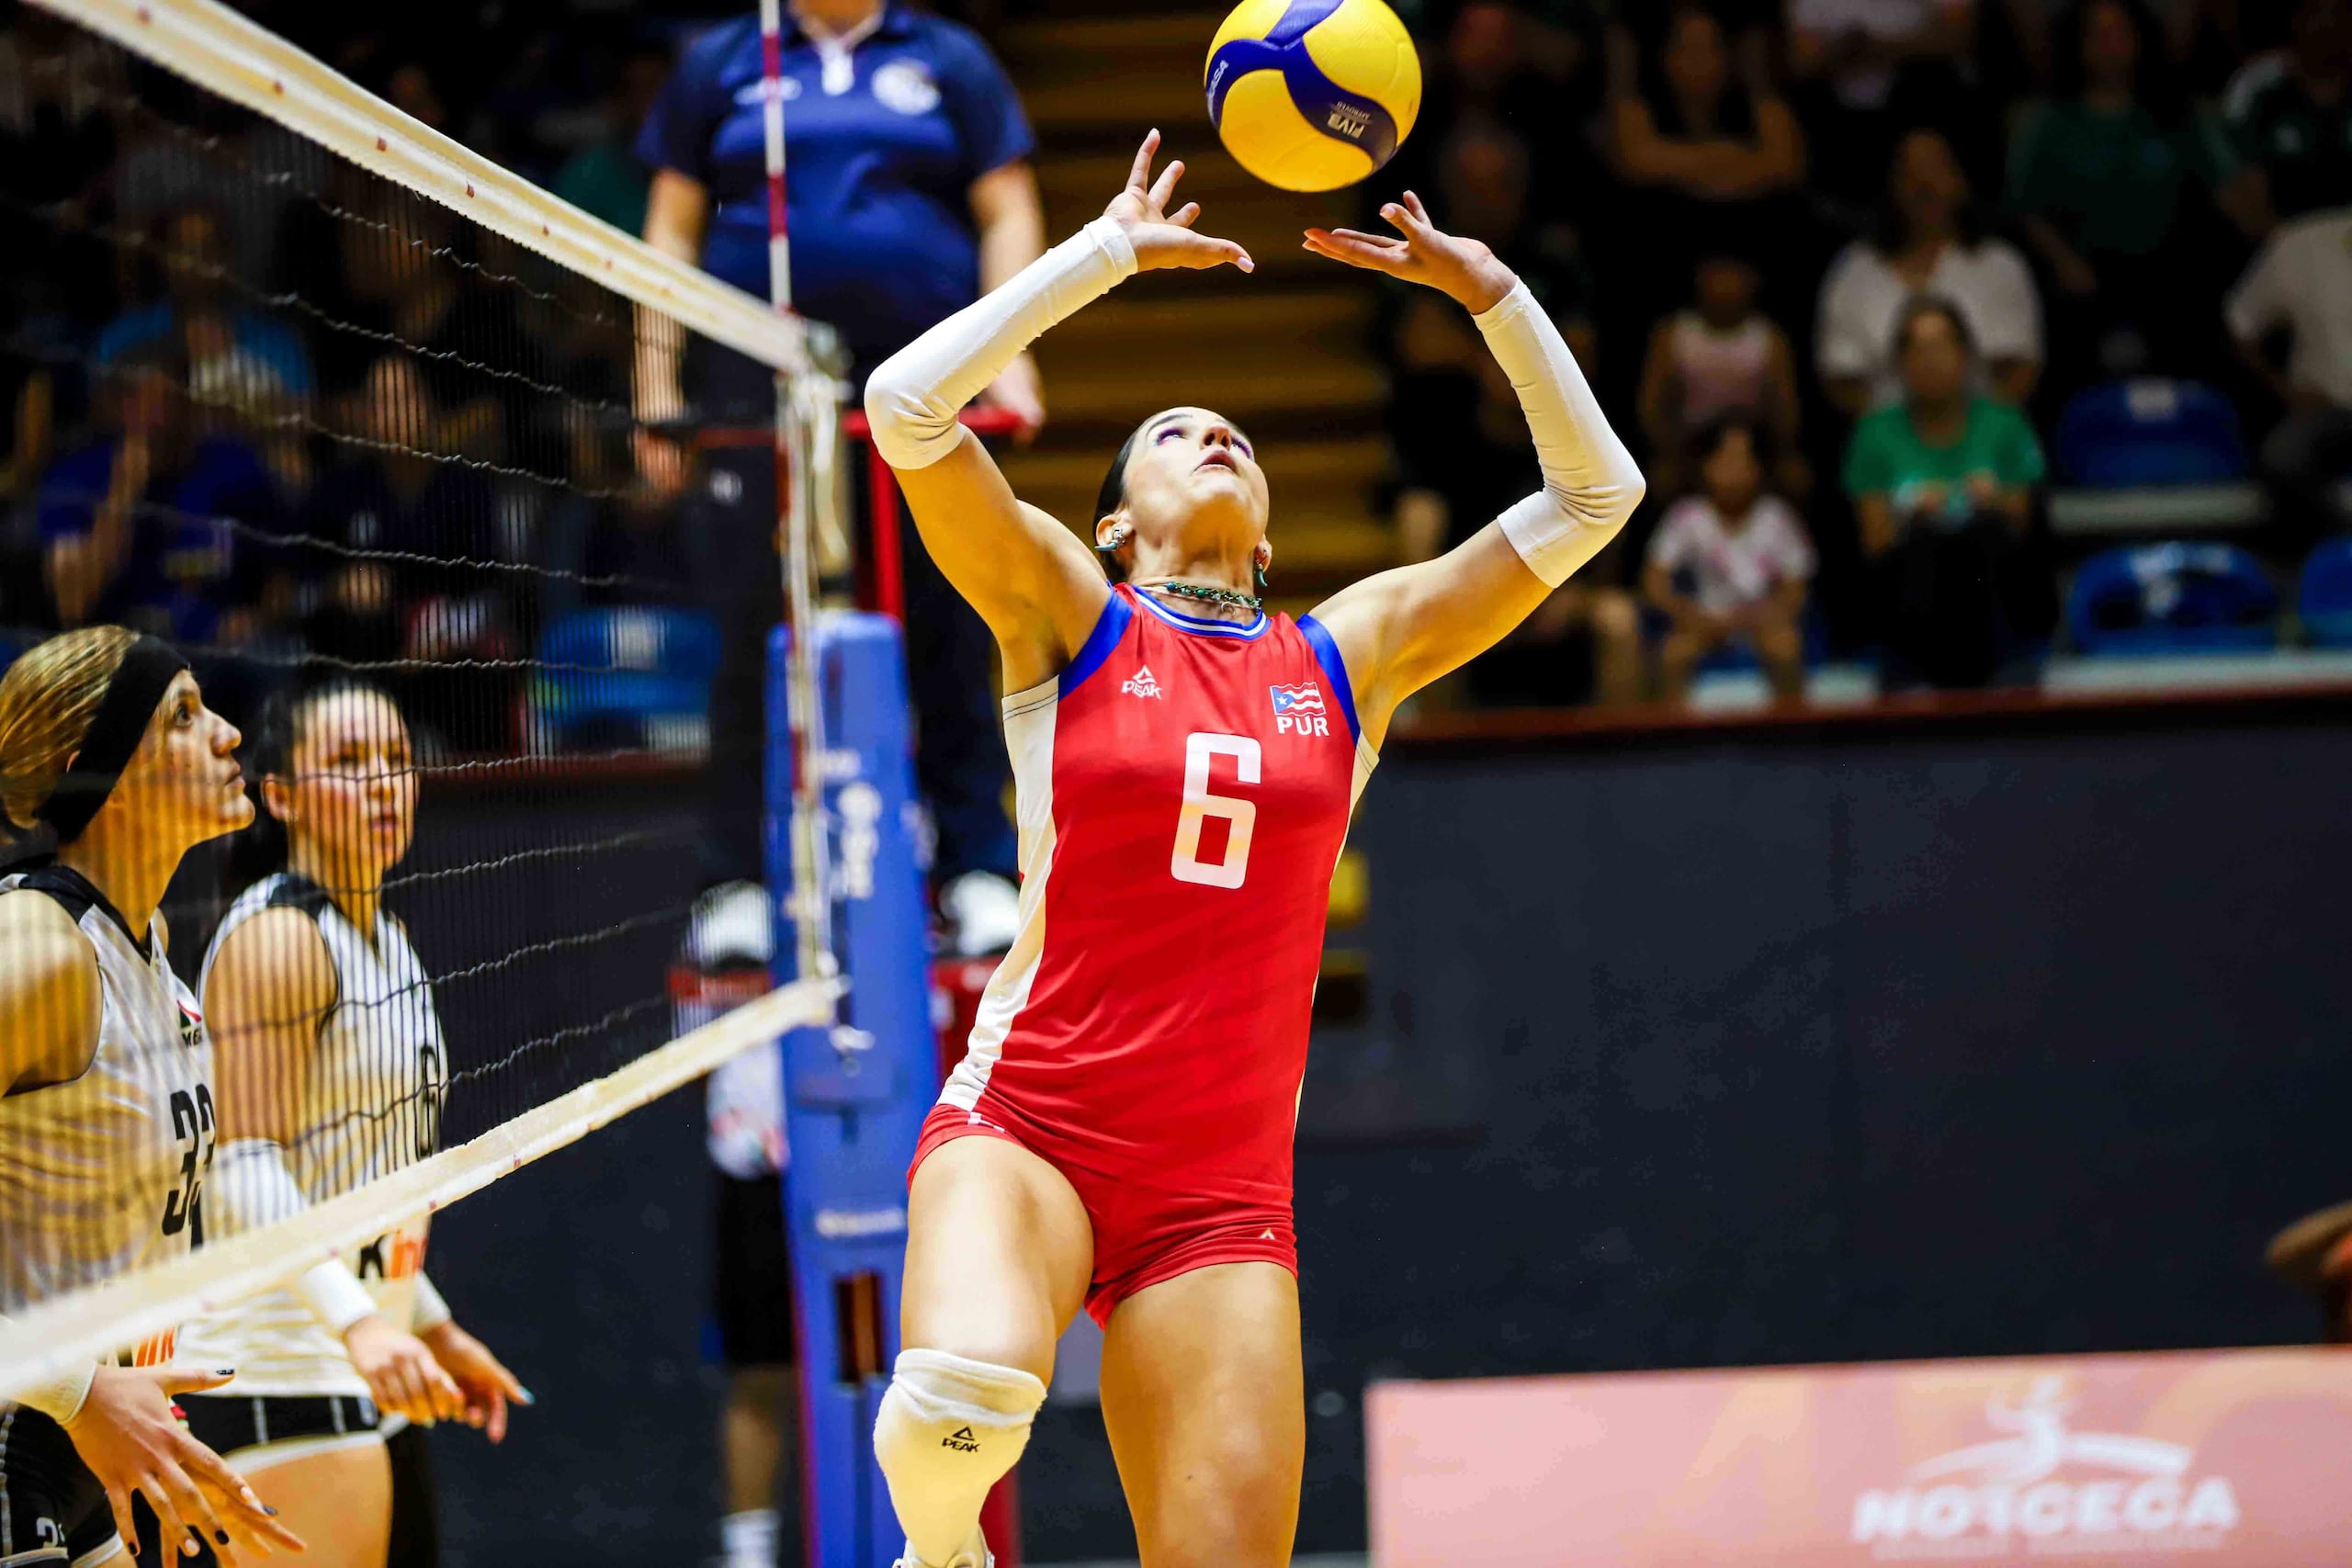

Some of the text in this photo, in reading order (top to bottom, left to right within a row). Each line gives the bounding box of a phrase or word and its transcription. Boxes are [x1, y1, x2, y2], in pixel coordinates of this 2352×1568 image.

[1327, 112, 1365, 139] FIVB
[1121, 680, 1162, 700] PEAK
[1276, 716, 1329, 737] PUR
[1170, 732, 1261, 889] 6
[942, 1438, 980, 1453] PEAK
